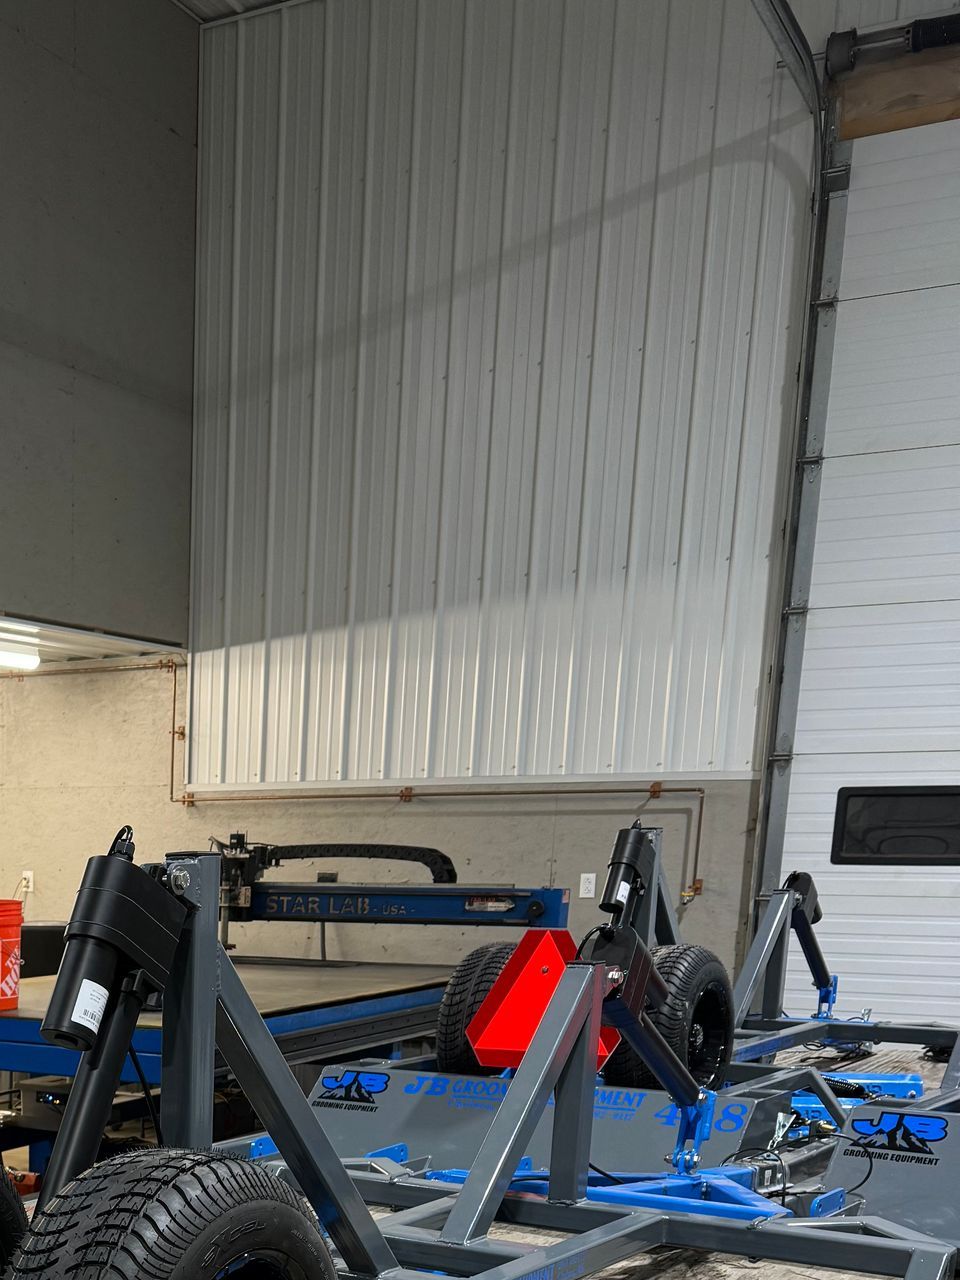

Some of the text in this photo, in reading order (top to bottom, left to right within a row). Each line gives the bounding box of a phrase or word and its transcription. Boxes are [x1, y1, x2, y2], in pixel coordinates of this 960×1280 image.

[266, 895, 320, 914] STAR
[328, 896, 370, 914] LAB
[321, 1070, 391, 1094] JB
[403, 1075, 451, 1097] JB
[451, 1079, 508, 1096] GROO
[311, 1100, 379, 1113] GROOMING EQUIPMENT
[653, 1103, 748, 1133] 48
[851, 1112, 949, 1142] JB
[842, 1149, 940, 1167] GROOMING EQUIPMENT
